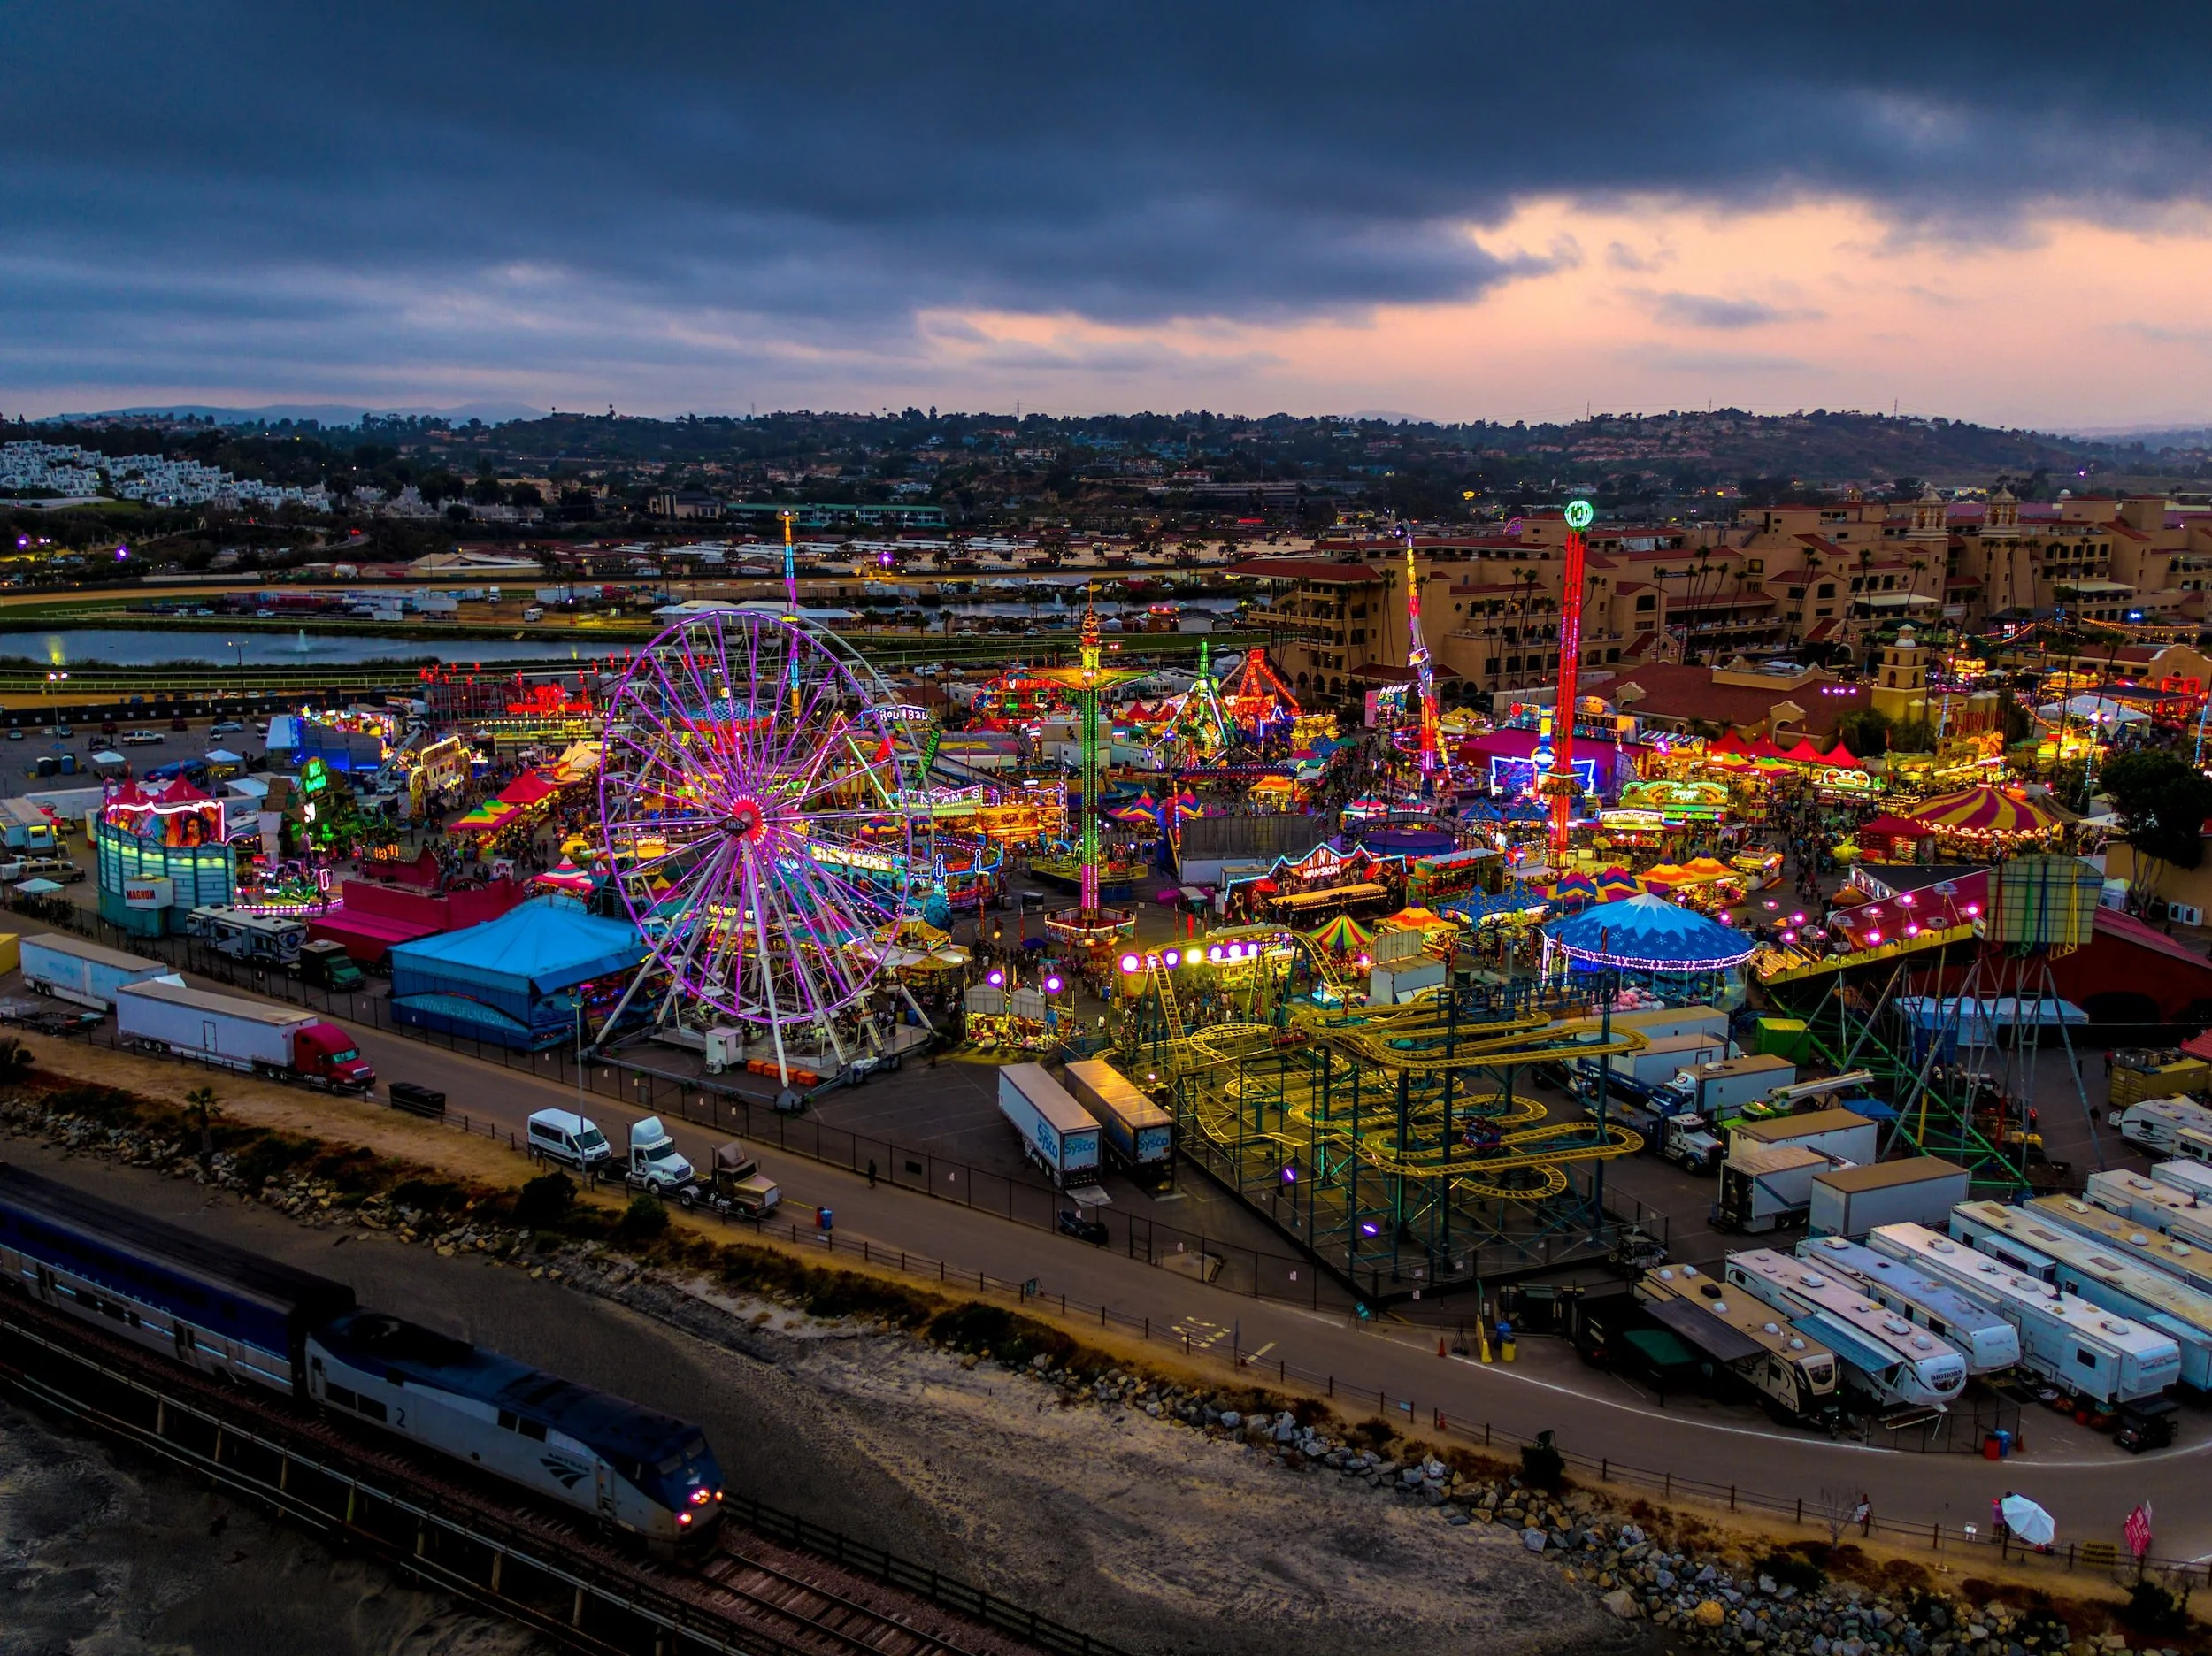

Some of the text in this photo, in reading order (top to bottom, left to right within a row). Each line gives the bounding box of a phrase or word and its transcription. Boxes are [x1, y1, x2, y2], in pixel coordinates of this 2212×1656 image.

[126, 889, 156, 901] MAGNUM
[415, 996, 504, 1026] WWW.RCSFUN.COM
[1931, 1369, 1963, 1381] BIGHORN
[396, 1407, 406, 1428] 2
